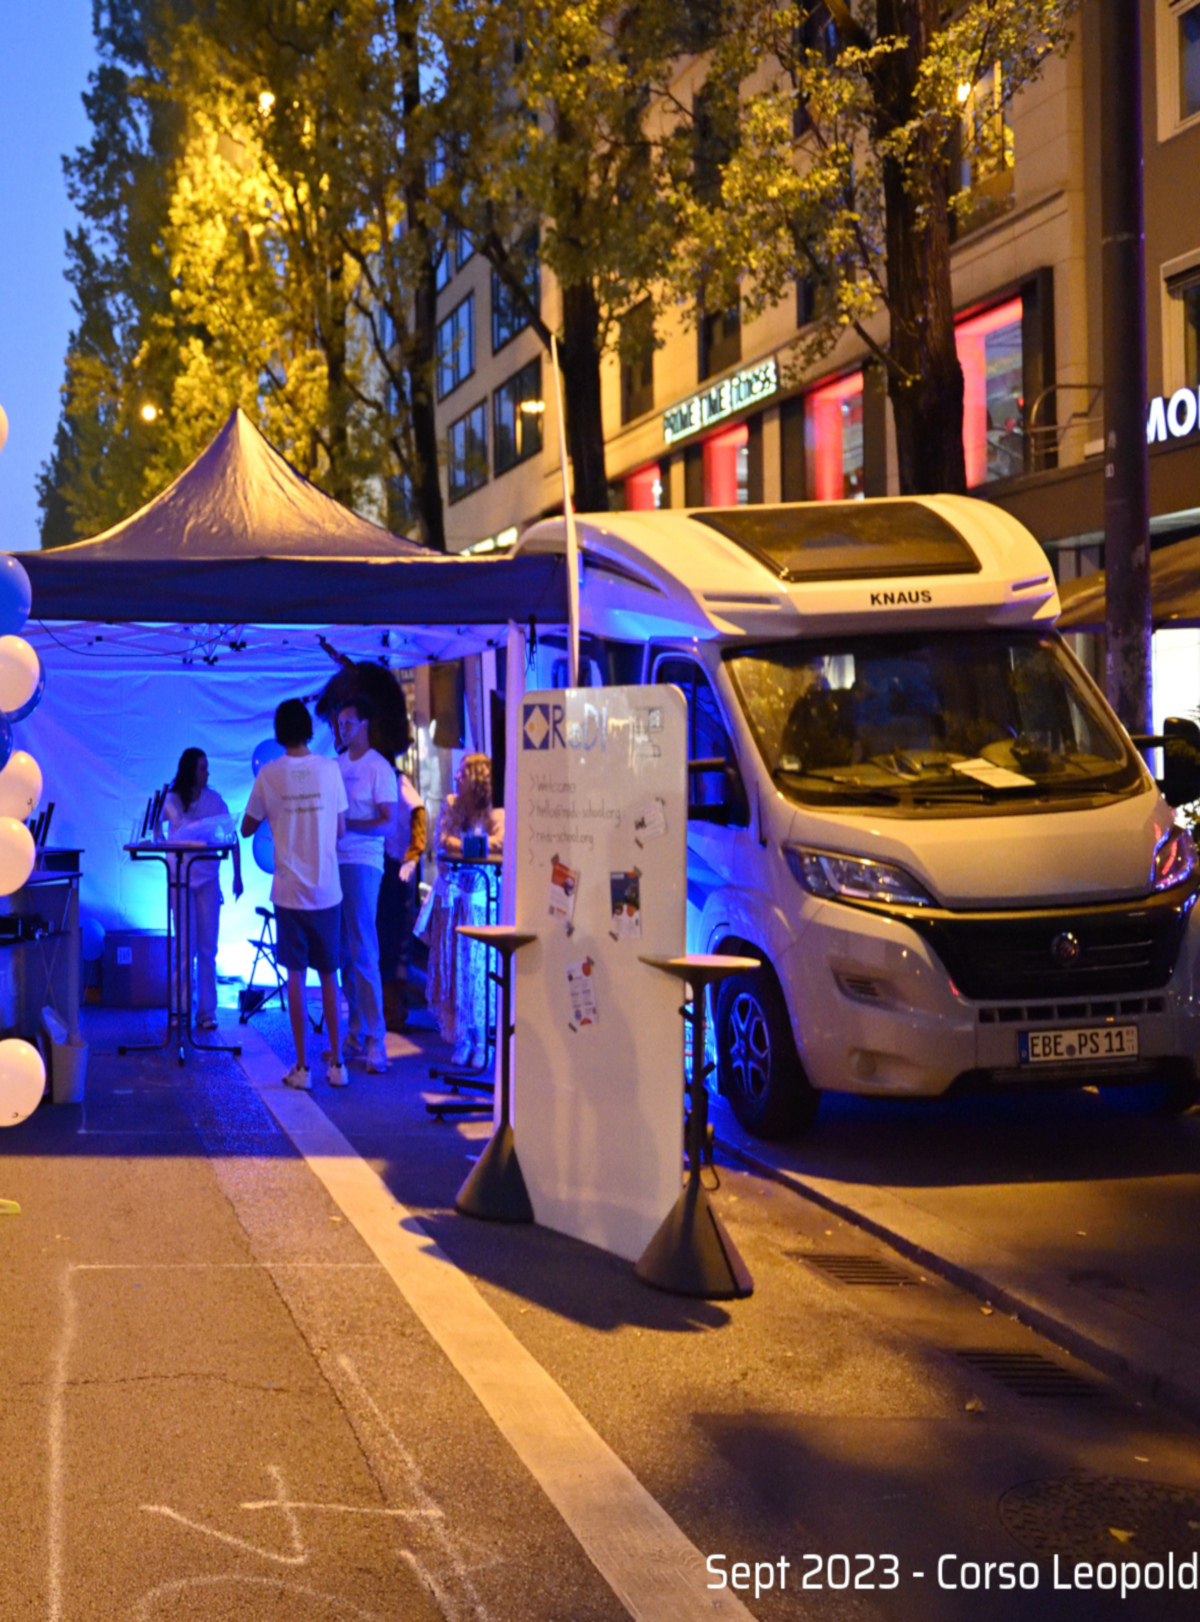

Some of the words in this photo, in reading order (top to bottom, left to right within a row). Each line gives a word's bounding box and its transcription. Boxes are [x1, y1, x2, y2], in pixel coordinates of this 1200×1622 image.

[702, 379, 732, 427] TIME
[1146, 384, 1200, 444] MO
[870, 590, 932, 605] KNAUS
[1030, 1035, 1064, 1058] EBE
[1077, 1032, 1099, 1055] PS
[1104, 1030, 1125, 1053] 11
